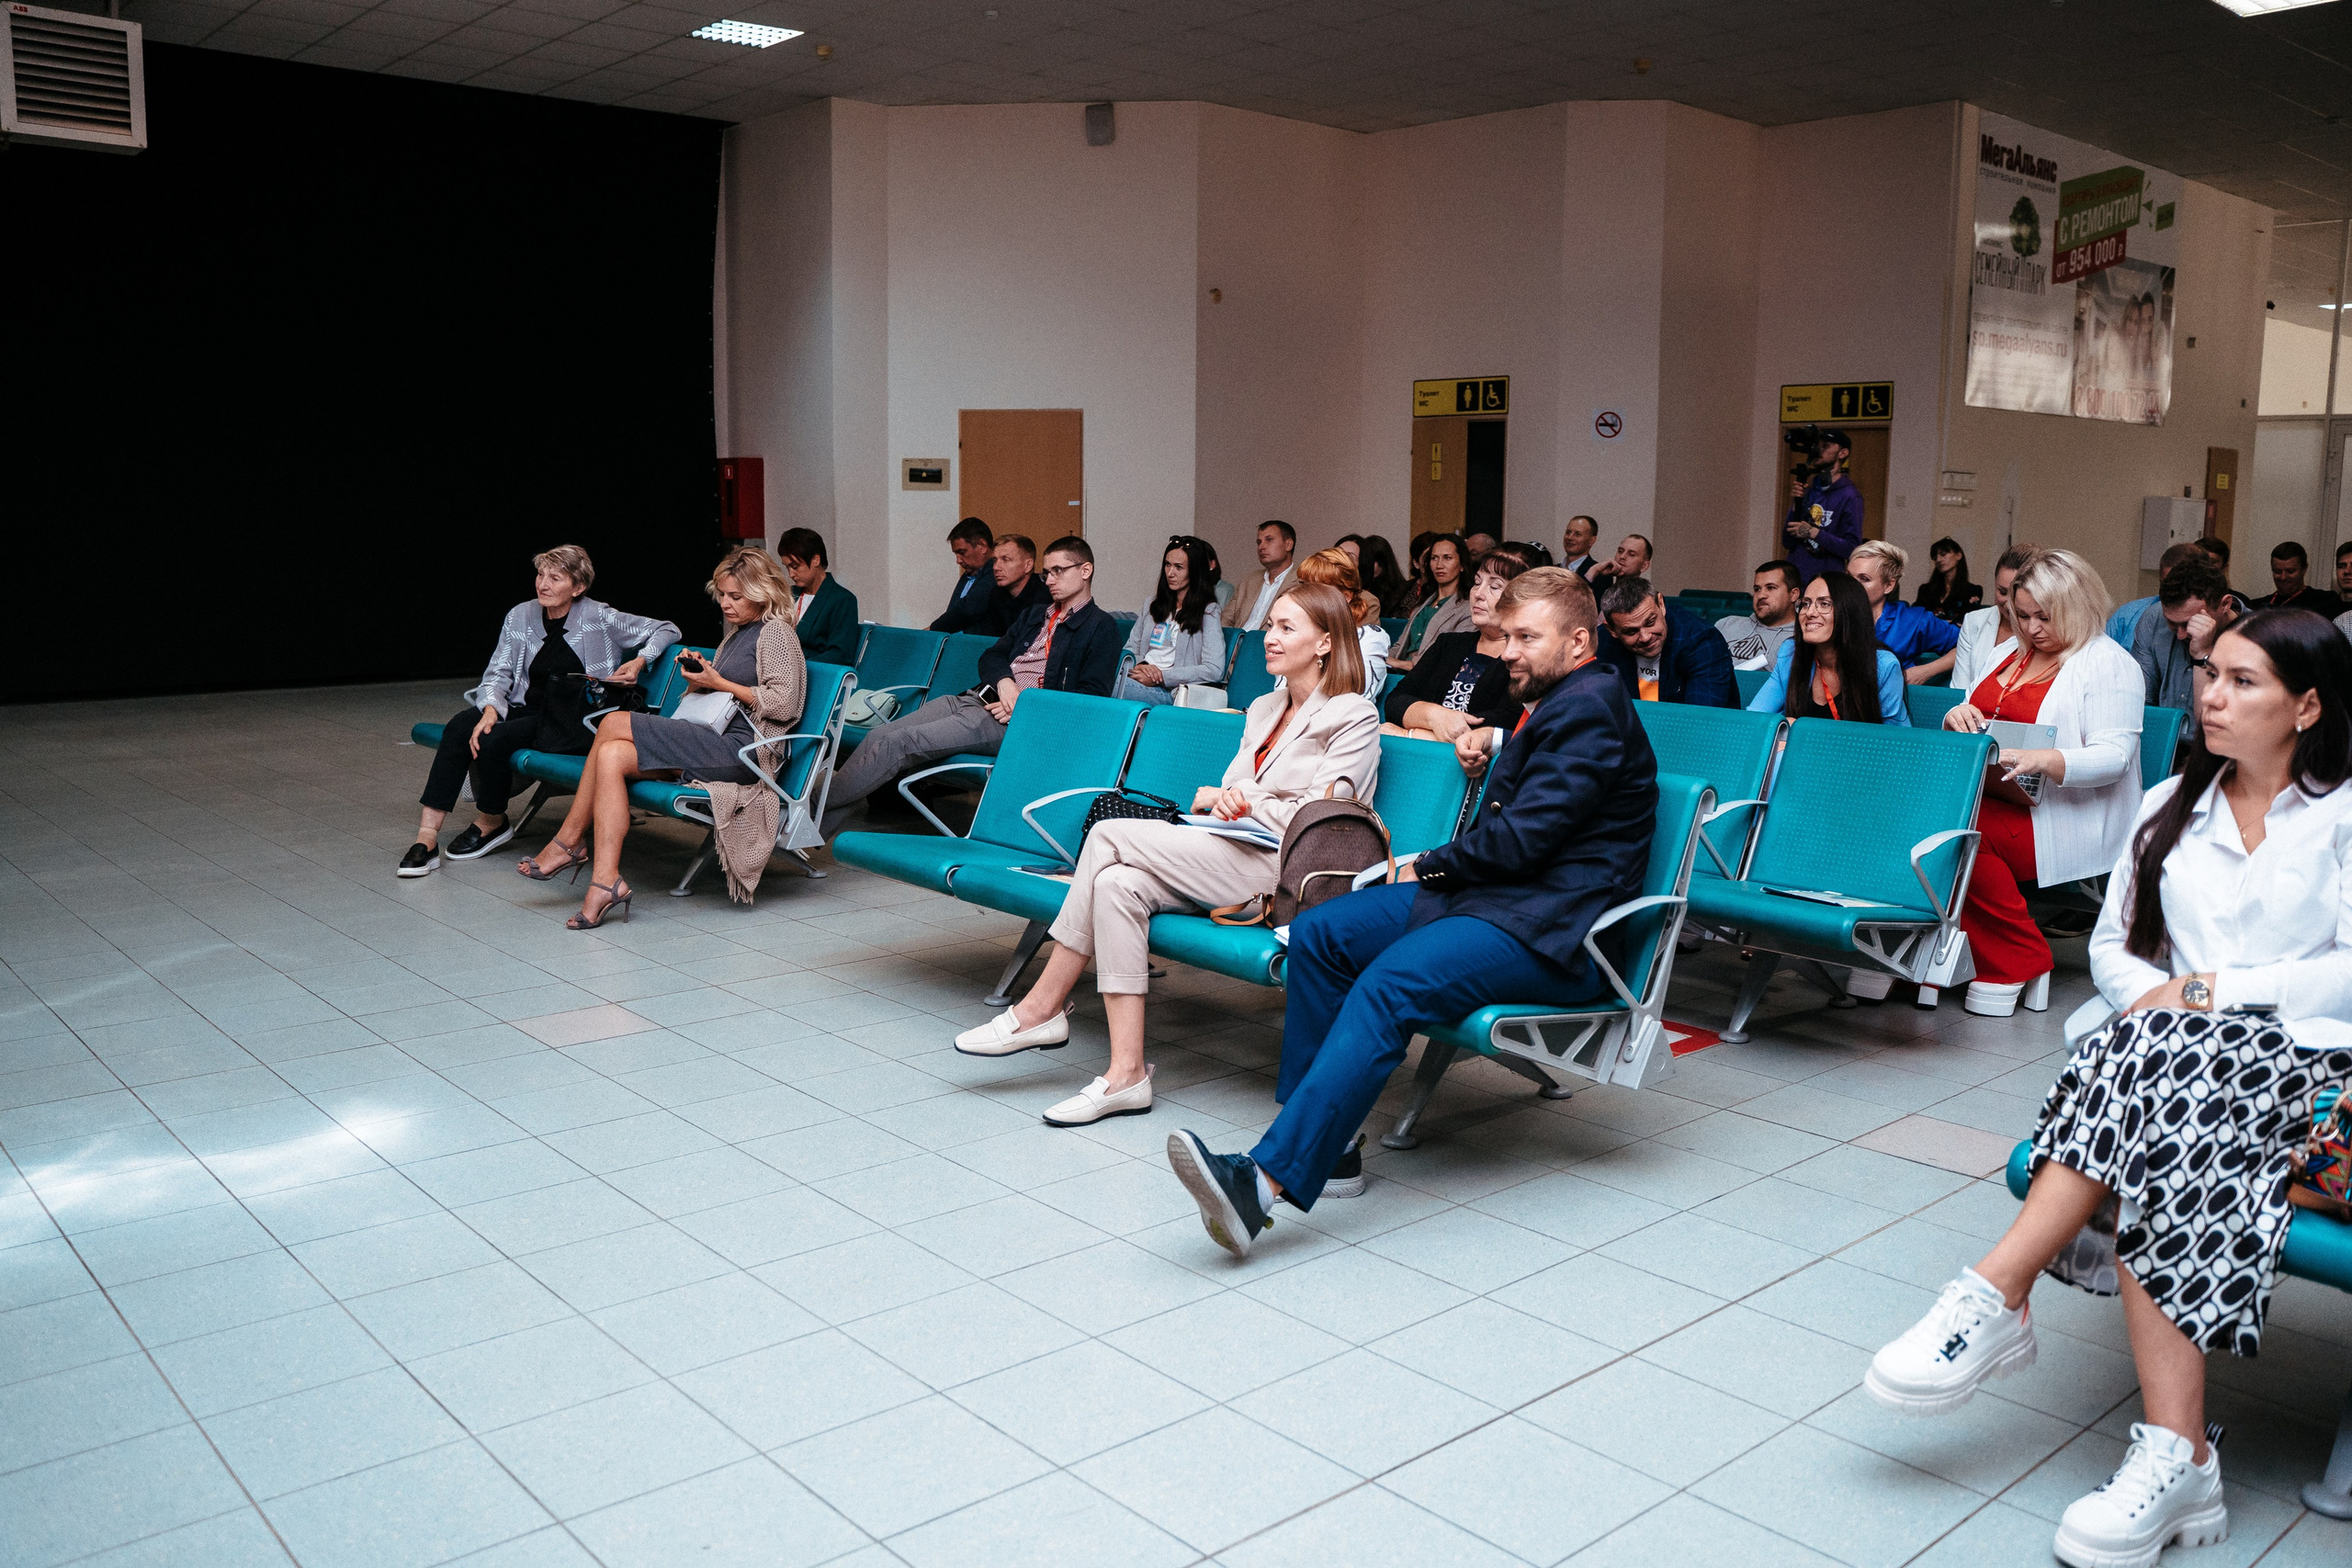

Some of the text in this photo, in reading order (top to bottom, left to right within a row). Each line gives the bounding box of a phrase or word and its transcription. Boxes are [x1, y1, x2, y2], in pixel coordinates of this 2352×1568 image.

[13, 5, 28, 13] ABB
[1980, 134, 2057, 183] МегаАльянс
[2059, 217, 2068, 245] С
[2071, 193, 2139, 241] РЕМОНТОМ
[1975, 251, 2019, 290] СЕМЕЙНЫЙ
[2069, 247, 2091, 275] 954
[2095, 237, 2117, 265] 000
[1972, 329, 2068, 358] sp.megaalyans.ru
